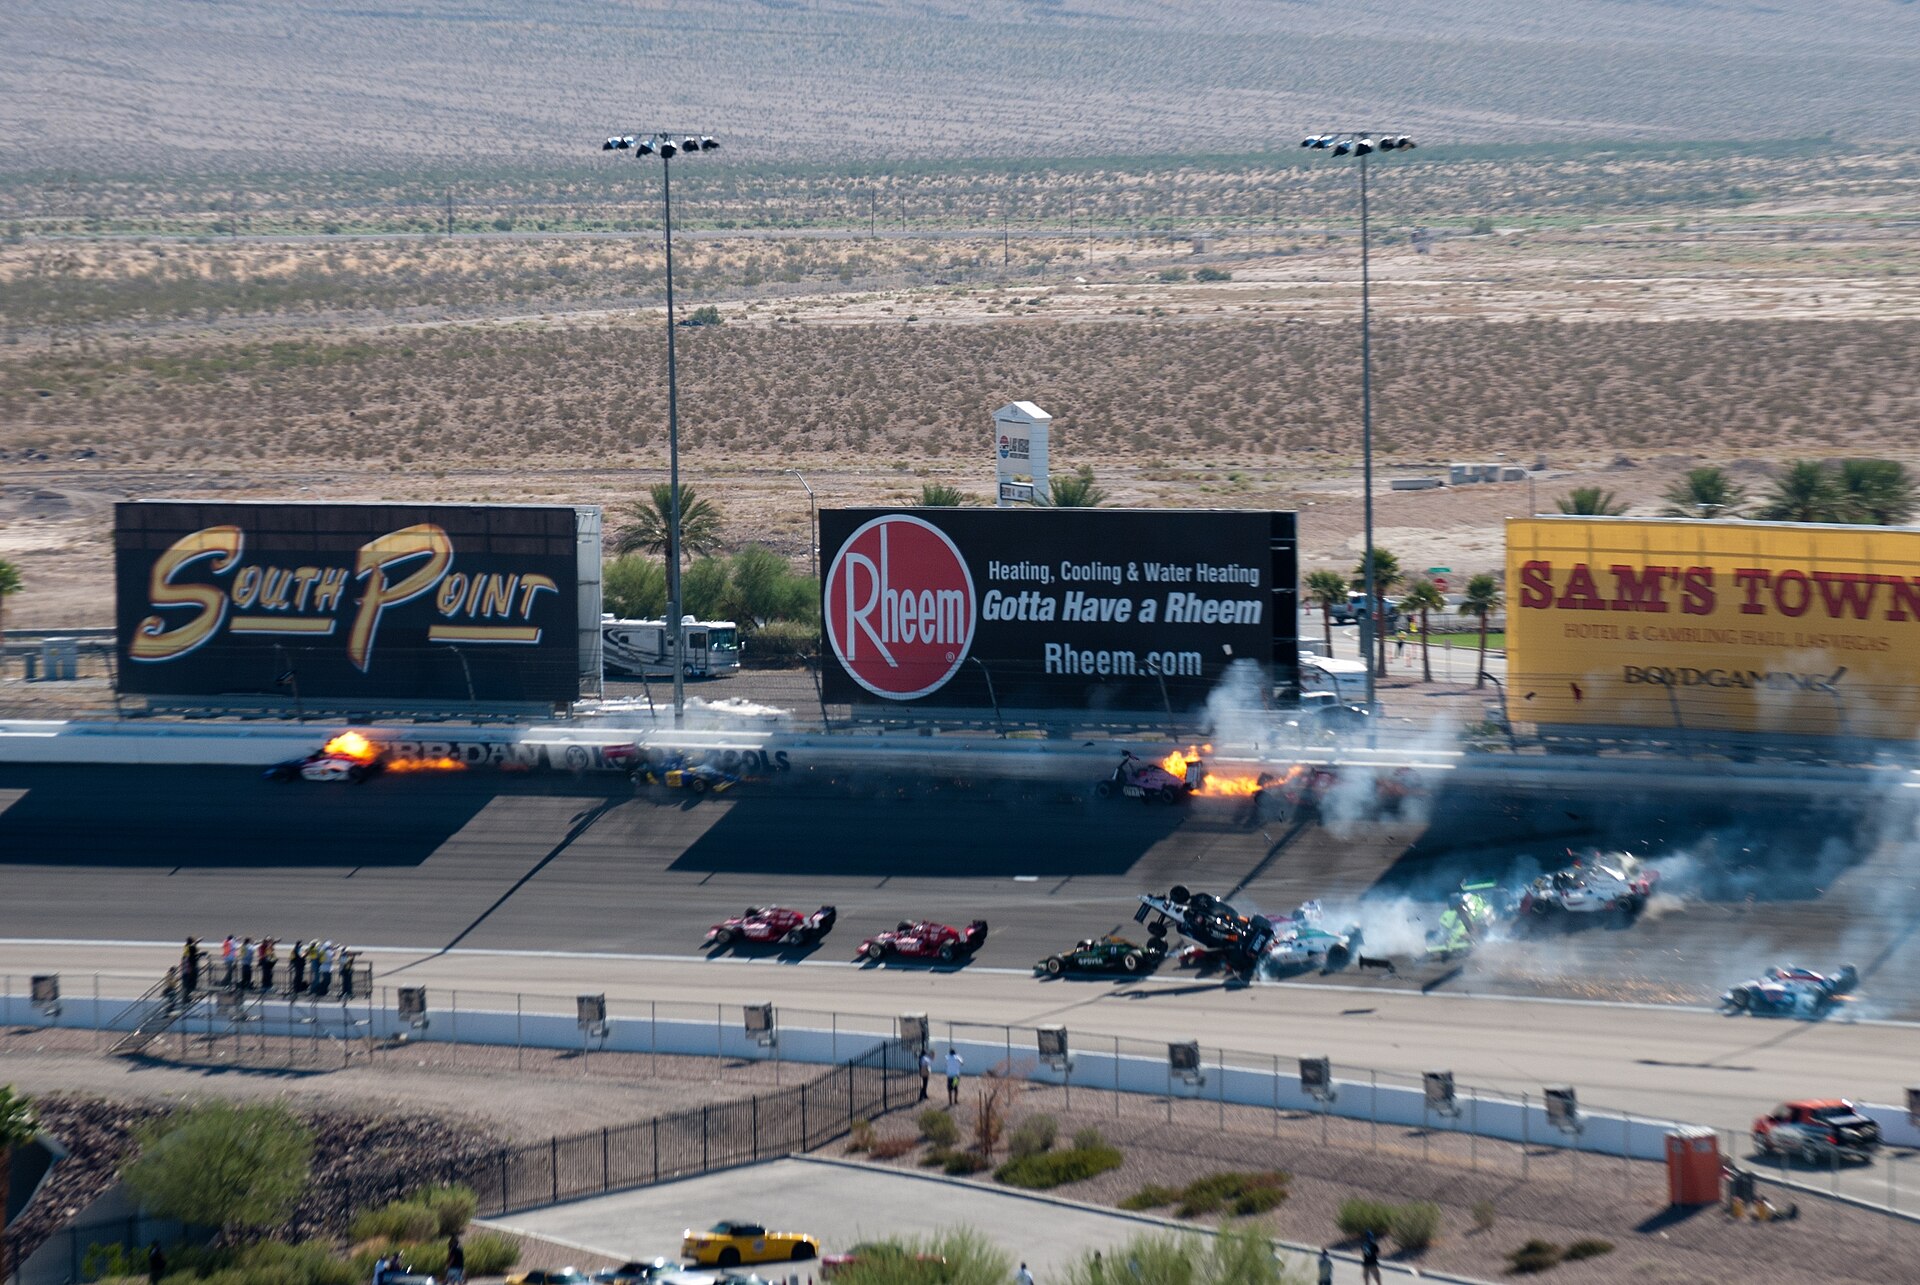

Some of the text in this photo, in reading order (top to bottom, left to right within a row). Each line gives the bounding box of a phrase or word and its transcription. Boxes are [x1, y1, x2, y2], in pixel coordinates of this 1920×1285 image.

[988, 561, 1260, 587] Heating, Cooling & Water Heating
[1519, 560, 1920, 622] SAM'S TOWN
[129, 523, 558, 672] SOUTH POINT
[845, 524, 965, 668] Rheem
[982, 589, 1263, 624] Gotta Have a Rheem
[1564, 623, 1621, 640] HOTEL
[1626, 625, 1640, 641] &
[1643, 625, 1738, 645] GAMBLING
[1740, 629, 1792, 648] HALL
[1044, 643, 1203, 676] Rheem.com
